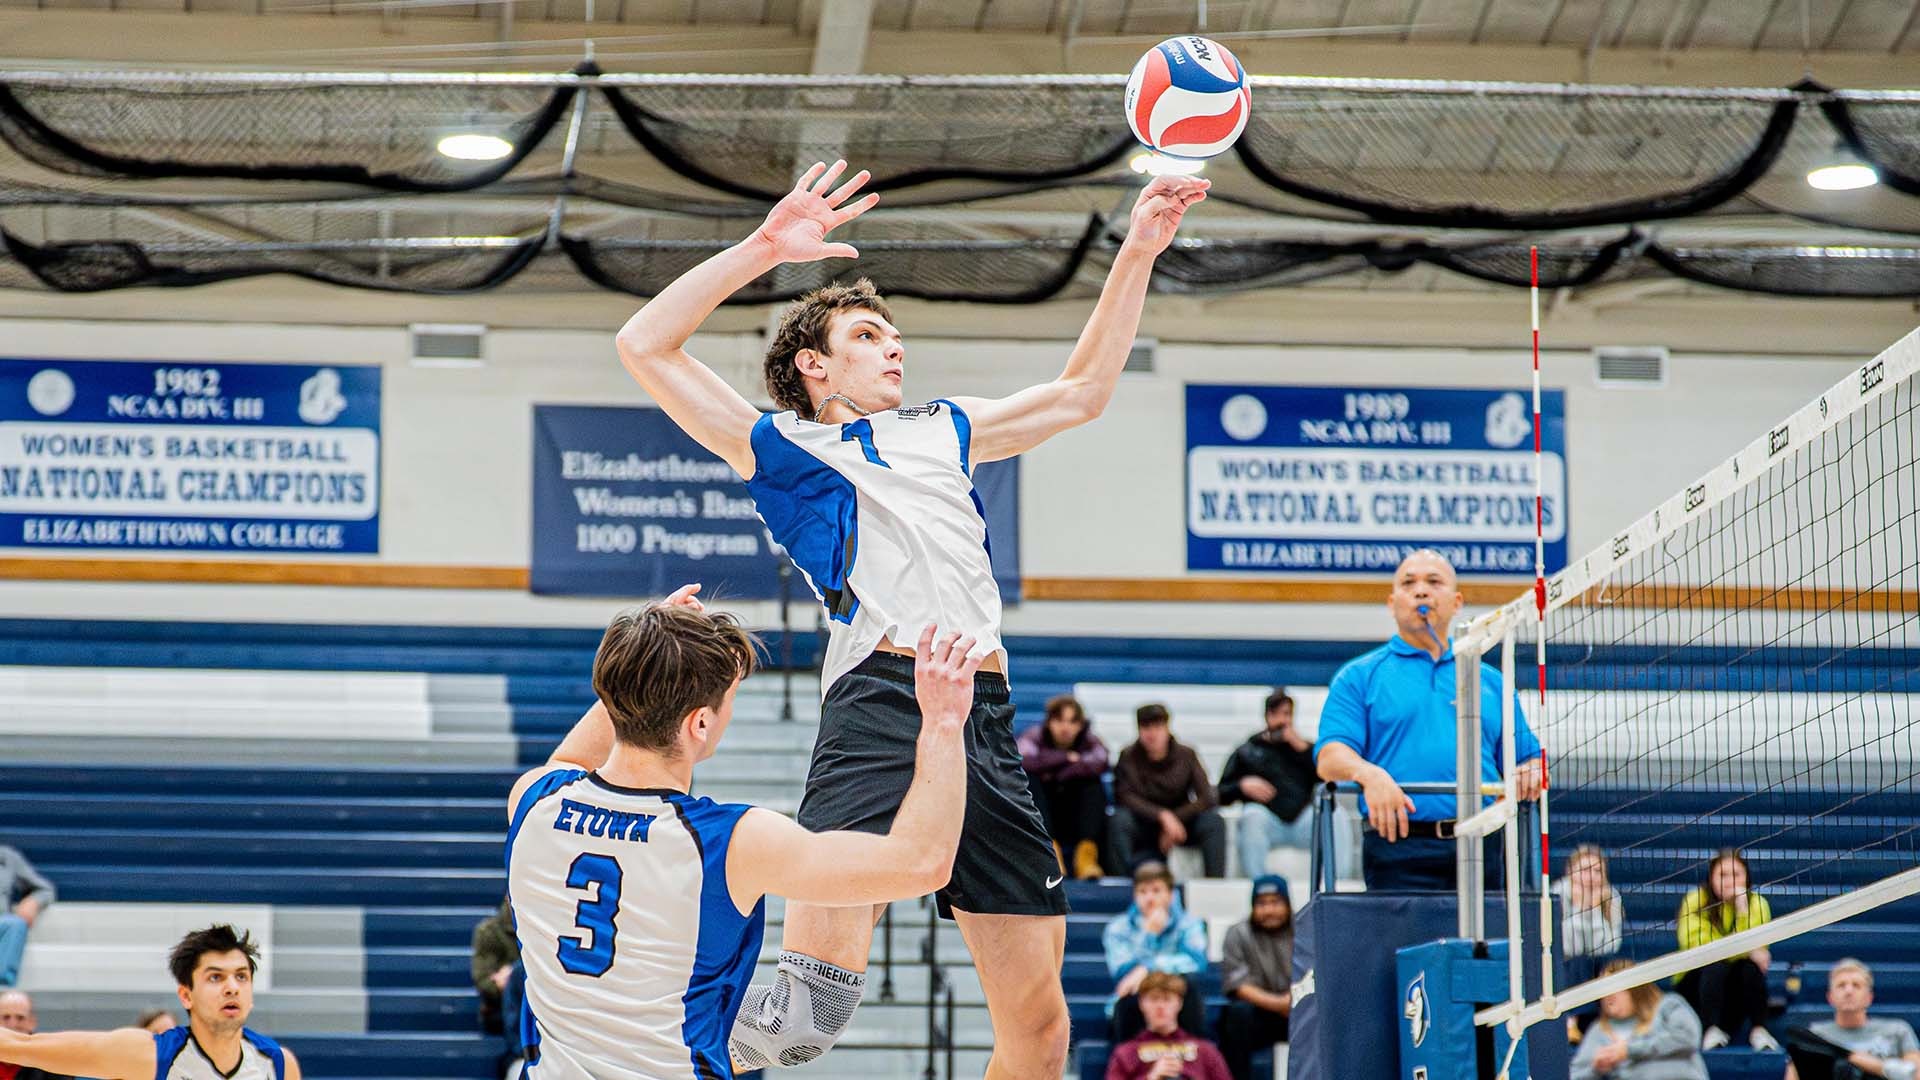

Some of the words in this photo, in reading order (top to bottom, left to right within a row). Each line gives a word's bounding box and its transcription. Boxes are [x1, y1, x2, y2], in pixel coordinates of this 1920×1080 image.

[153, 367, 222, 397] 1982
[107, 394, 179, 419] NCAA
[233, 397, 265, 420] III
[1344, 393, 1410, 421] 1989
[1300, 419, 1369, 443] NCAA
[20, 433, 156, 458] WOMEN'S
[165, 436, 348, 463] BASKETBALL
[0, 464, 167, 501] NATIONAL
[177, 468, 367, 504] CHAMPIONS
[1219, 458, 1350, 482] WOMEN'S
[1359, 461, 1537, 487] BASKETBALL
[573, 487, 698, 518] Women's
[1200, 489, 1362, 524] NATIONAL
[1373, 492, 1555, 527] CHAMPIONS
[22, 518, 228, 546] ELIZABETHTOWN
[231, 522, 345, 549] COLLEGE
[576, 523, 637, 553] 1100
[641, 525, 758, 560] Program
[1434, 545, 1535, 571] OLLEGE
[553, 798, 658, 843] ETOWN
[556, 851, 624, 978] 3
[817, 963, 859, 988] NEENCA
